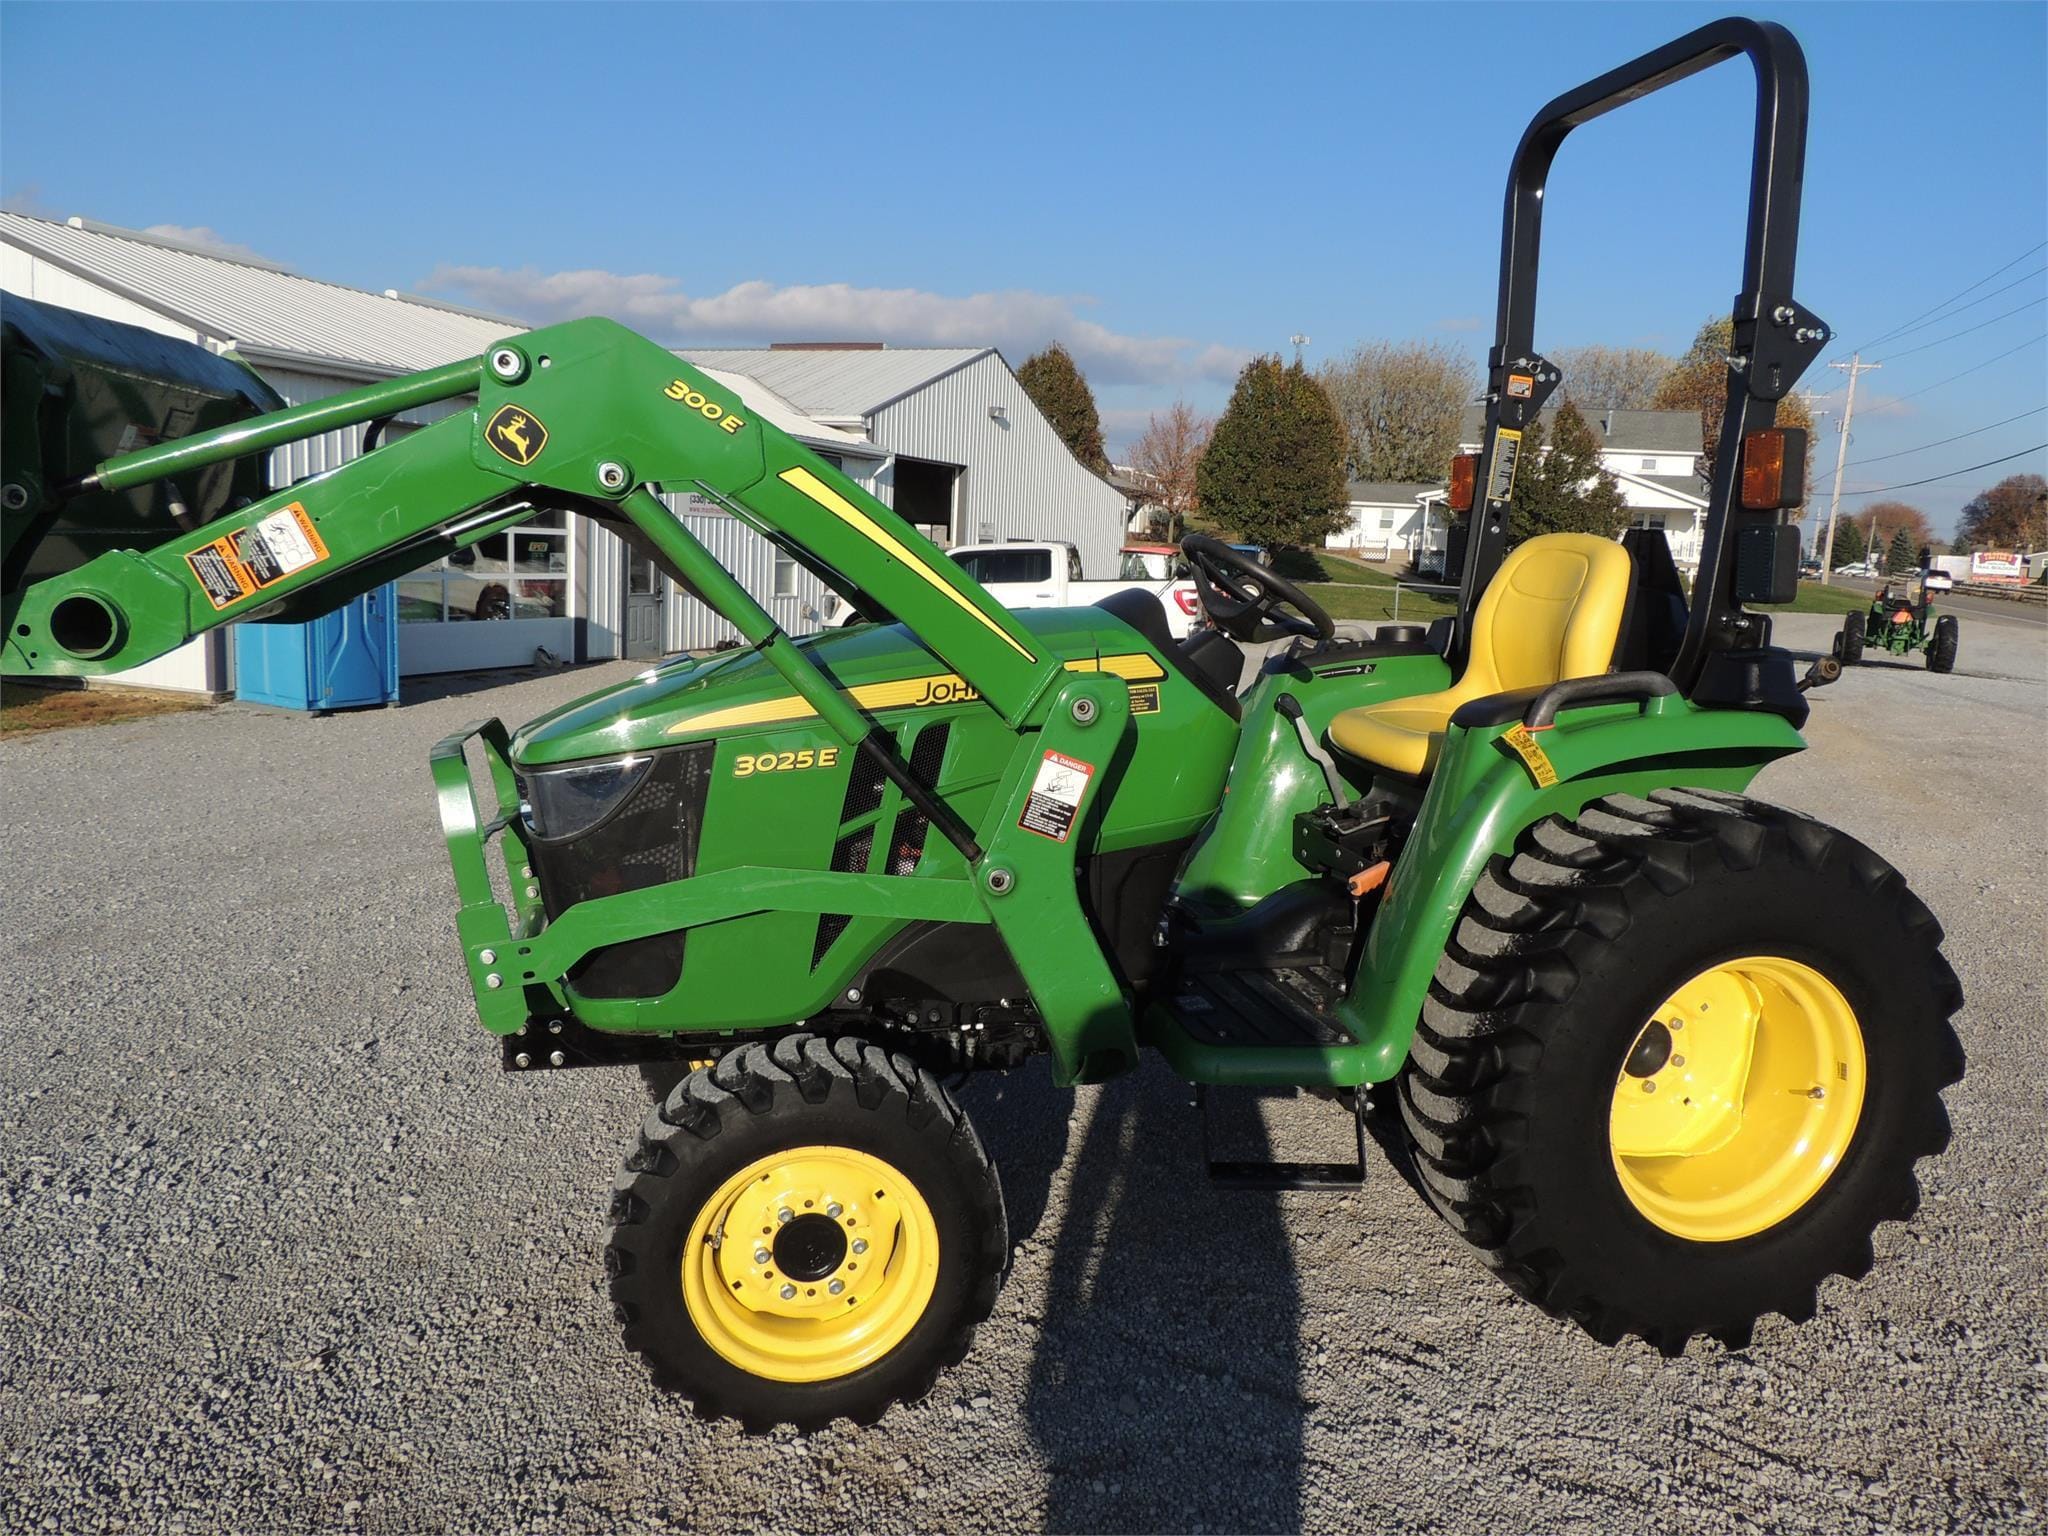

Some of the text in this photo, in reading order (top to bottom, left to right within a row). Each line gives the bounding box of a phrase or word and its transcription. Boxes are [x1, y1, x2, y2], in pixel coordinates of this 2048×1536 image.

[663, 379, 745, 434] 300 E
[299, 518, 322, 553] WARNING
[225, 552, 250, 590] WARNING
[734, 748, 839, 777] 3025 E
[1059, 757, 1087, 773] DANGER
